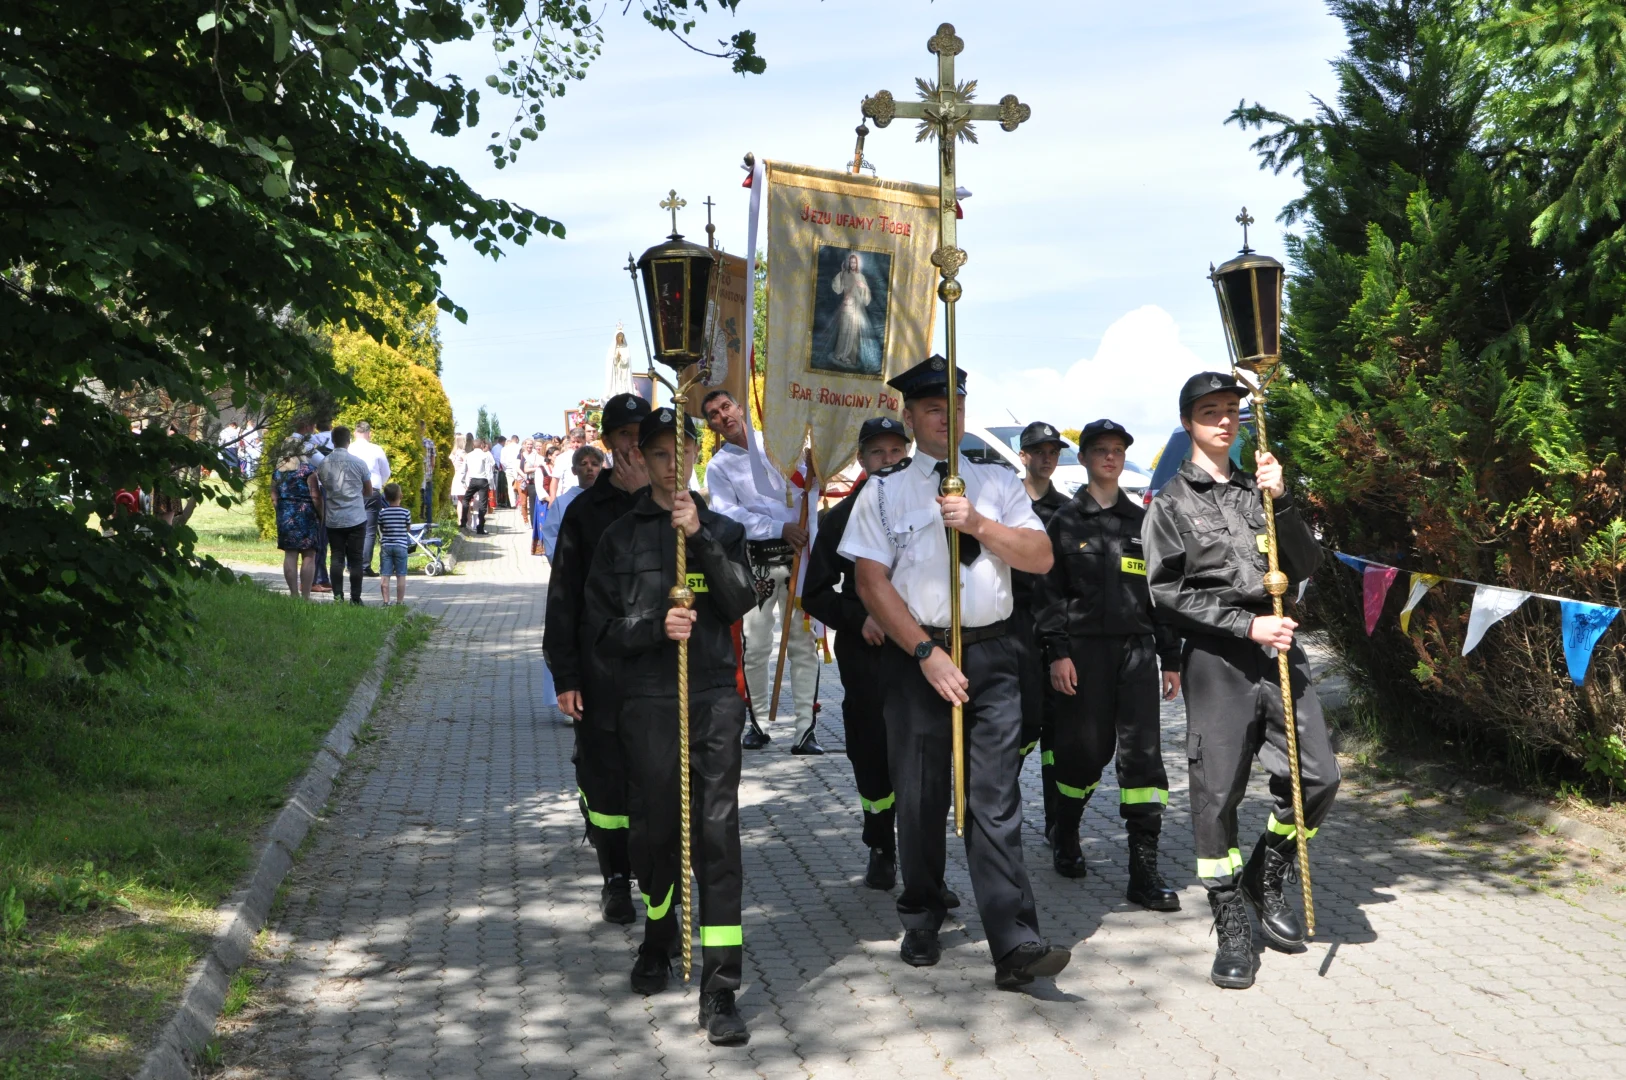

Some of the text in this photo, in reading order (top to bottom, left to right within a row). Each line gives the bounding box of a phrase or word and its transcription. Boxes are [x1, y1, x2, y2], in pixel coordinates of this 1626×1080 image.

[800, 202, 911, 237] JEZU UFAMY TOBIE
[791, 382, 812, 401] PAR
[819, 387, 873, 409] ROKICINY
[1127, 560, 1146, 572] STR
